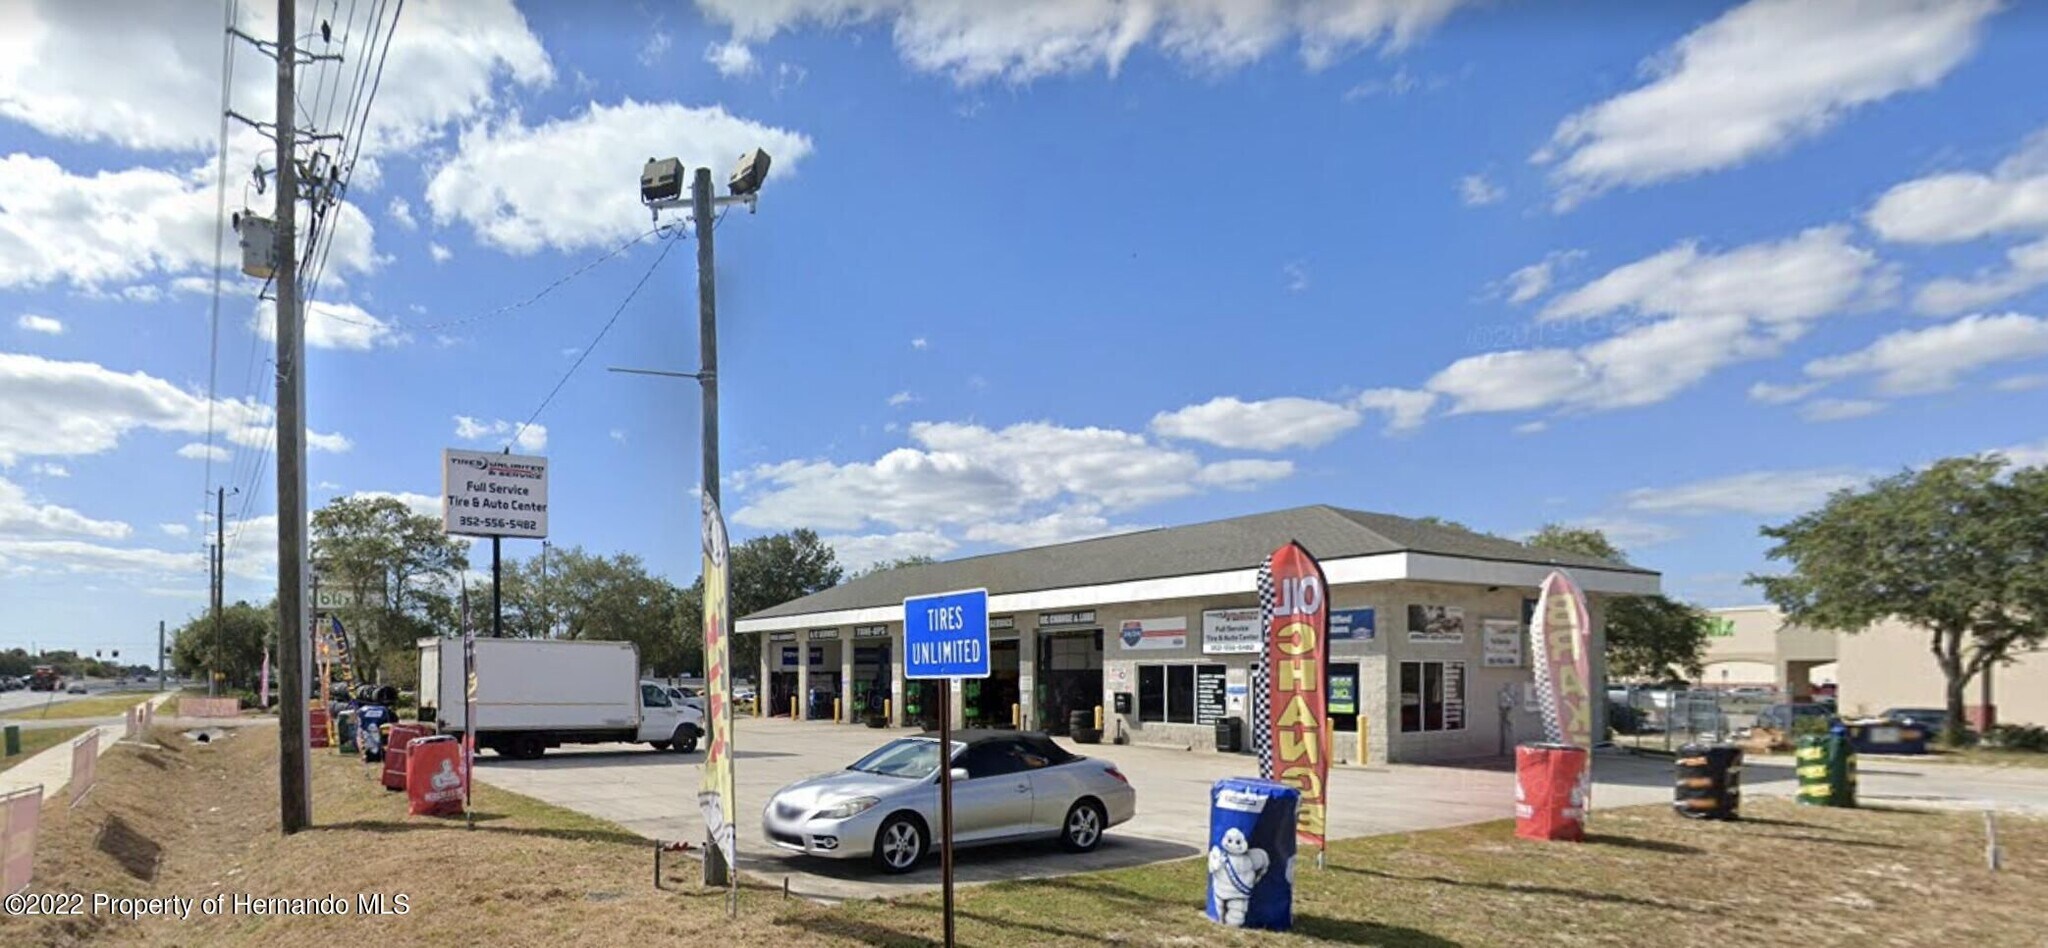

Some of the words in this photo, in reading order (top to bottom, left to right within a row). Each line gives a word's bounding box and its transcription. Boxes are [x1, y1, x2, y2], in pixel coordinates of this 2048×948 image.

[466, 481, 487, 492] Full
[489, 482, 529, 496] Service
[448, 495, 470, 508] Tire
[472, 497, 480, 508] &
[482, 498, 509, 510] Auto
[511, 500, 547, 513] Center
[460, 516, 537, 530] 352-556-5482
[927, 605, 963, 632] TIRES
[912, 639, 980, 665] UNLIMITED
